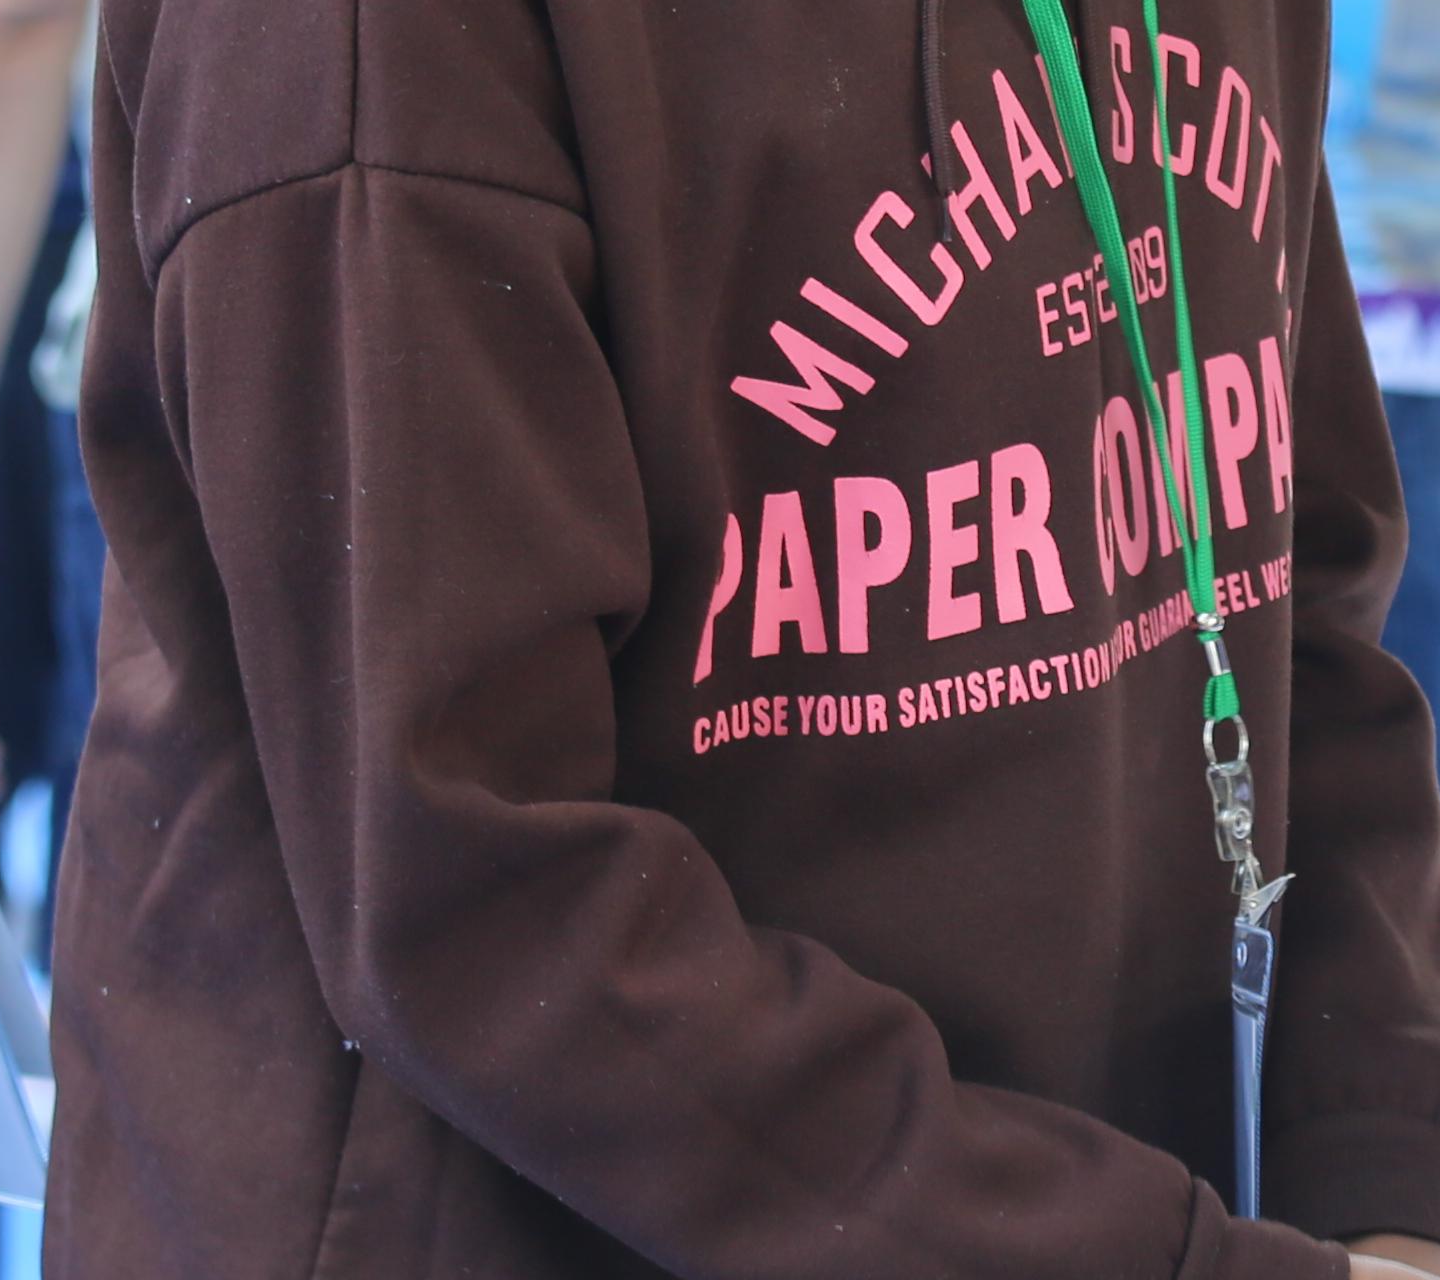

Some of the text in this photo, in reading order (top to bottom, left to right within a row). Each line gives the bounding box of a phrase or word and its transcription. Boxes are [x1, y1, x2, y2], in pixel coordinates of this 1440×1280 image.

[730, 25, 1287, 447] MICHA SCOT
[1094, 225, 1167, 323] 209
[1093, 336, 1293, 596] COMPA
[692, 695, 789, 755] CAUSE
[798, 694, 889, 737] YOUR
[898, 641, 1111, 729] SATISFACTION
